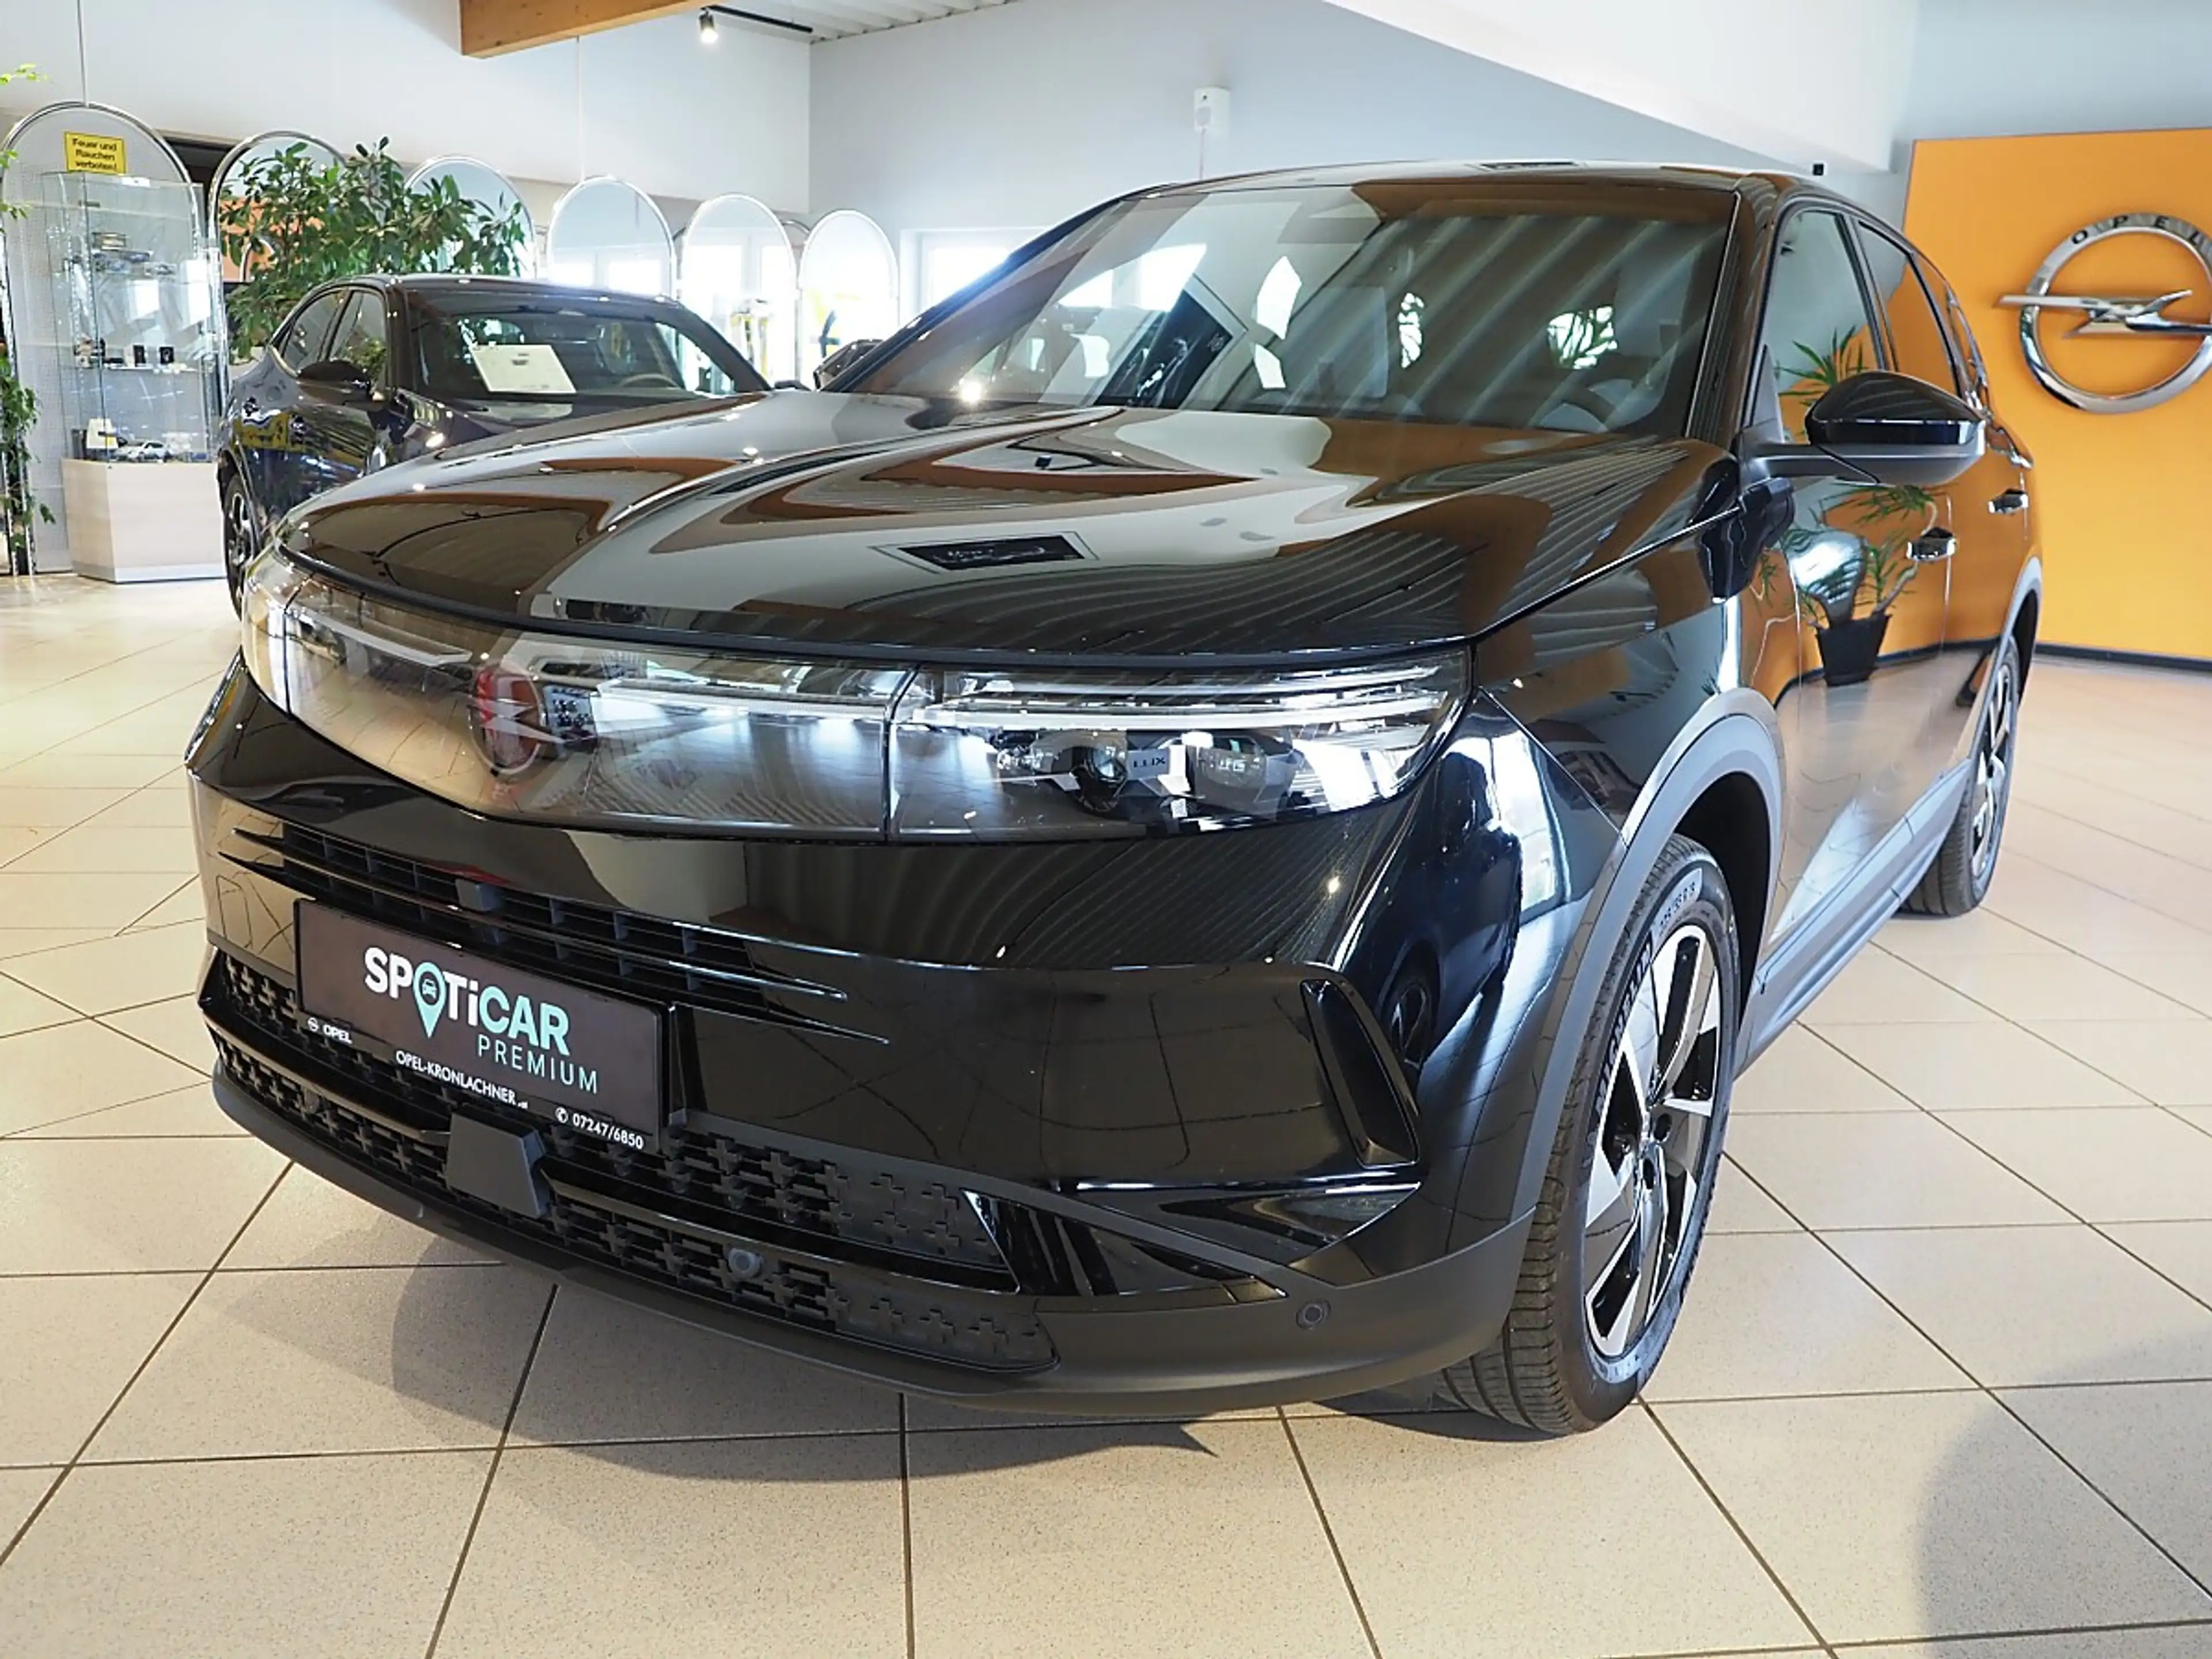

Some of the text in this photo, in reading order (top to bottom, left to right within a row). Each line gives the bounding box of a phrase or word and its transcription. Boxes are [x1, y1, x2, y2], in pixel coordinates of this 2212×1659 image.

[72, 138, 117, 151] Feuer und
[75, 149, 115, 161] Rauchen
[2071, 215, 2200, 246] OPEL
[323, 1024, 353, 1045] OPEL
[478, 1034, 598, 1094] PREMIUM
[572, 1112, 645, 1150] 07247/6850
